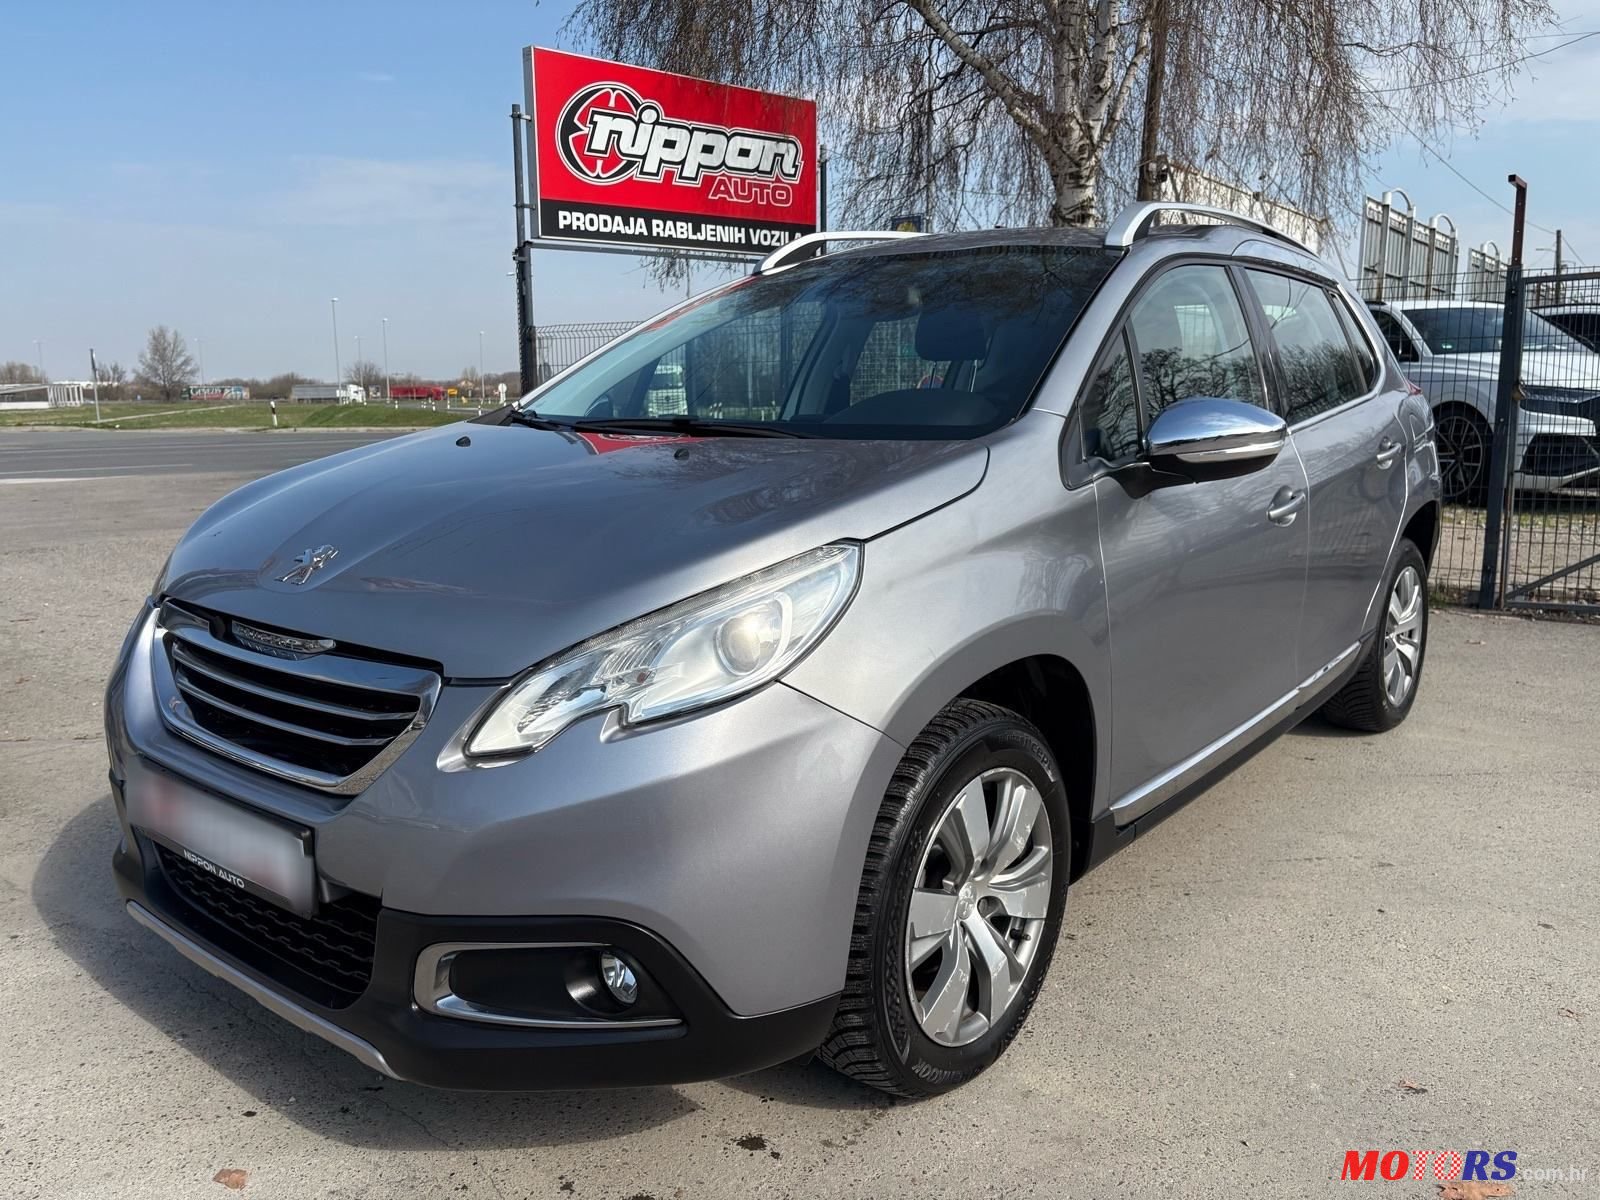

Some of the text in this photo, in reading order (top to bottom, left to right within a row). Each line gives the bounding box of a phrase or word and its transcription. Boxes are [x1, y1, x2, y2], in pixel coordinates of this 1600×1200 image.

[587, 104, 800, 182] nippon
[708, 176, 793, 207] AUTO
[558, 210, 648, 236] PRODAJA
[651, 219, 746, 244] RABLJENIH
[183, 849, 245, 888] NIPPON AUTO
